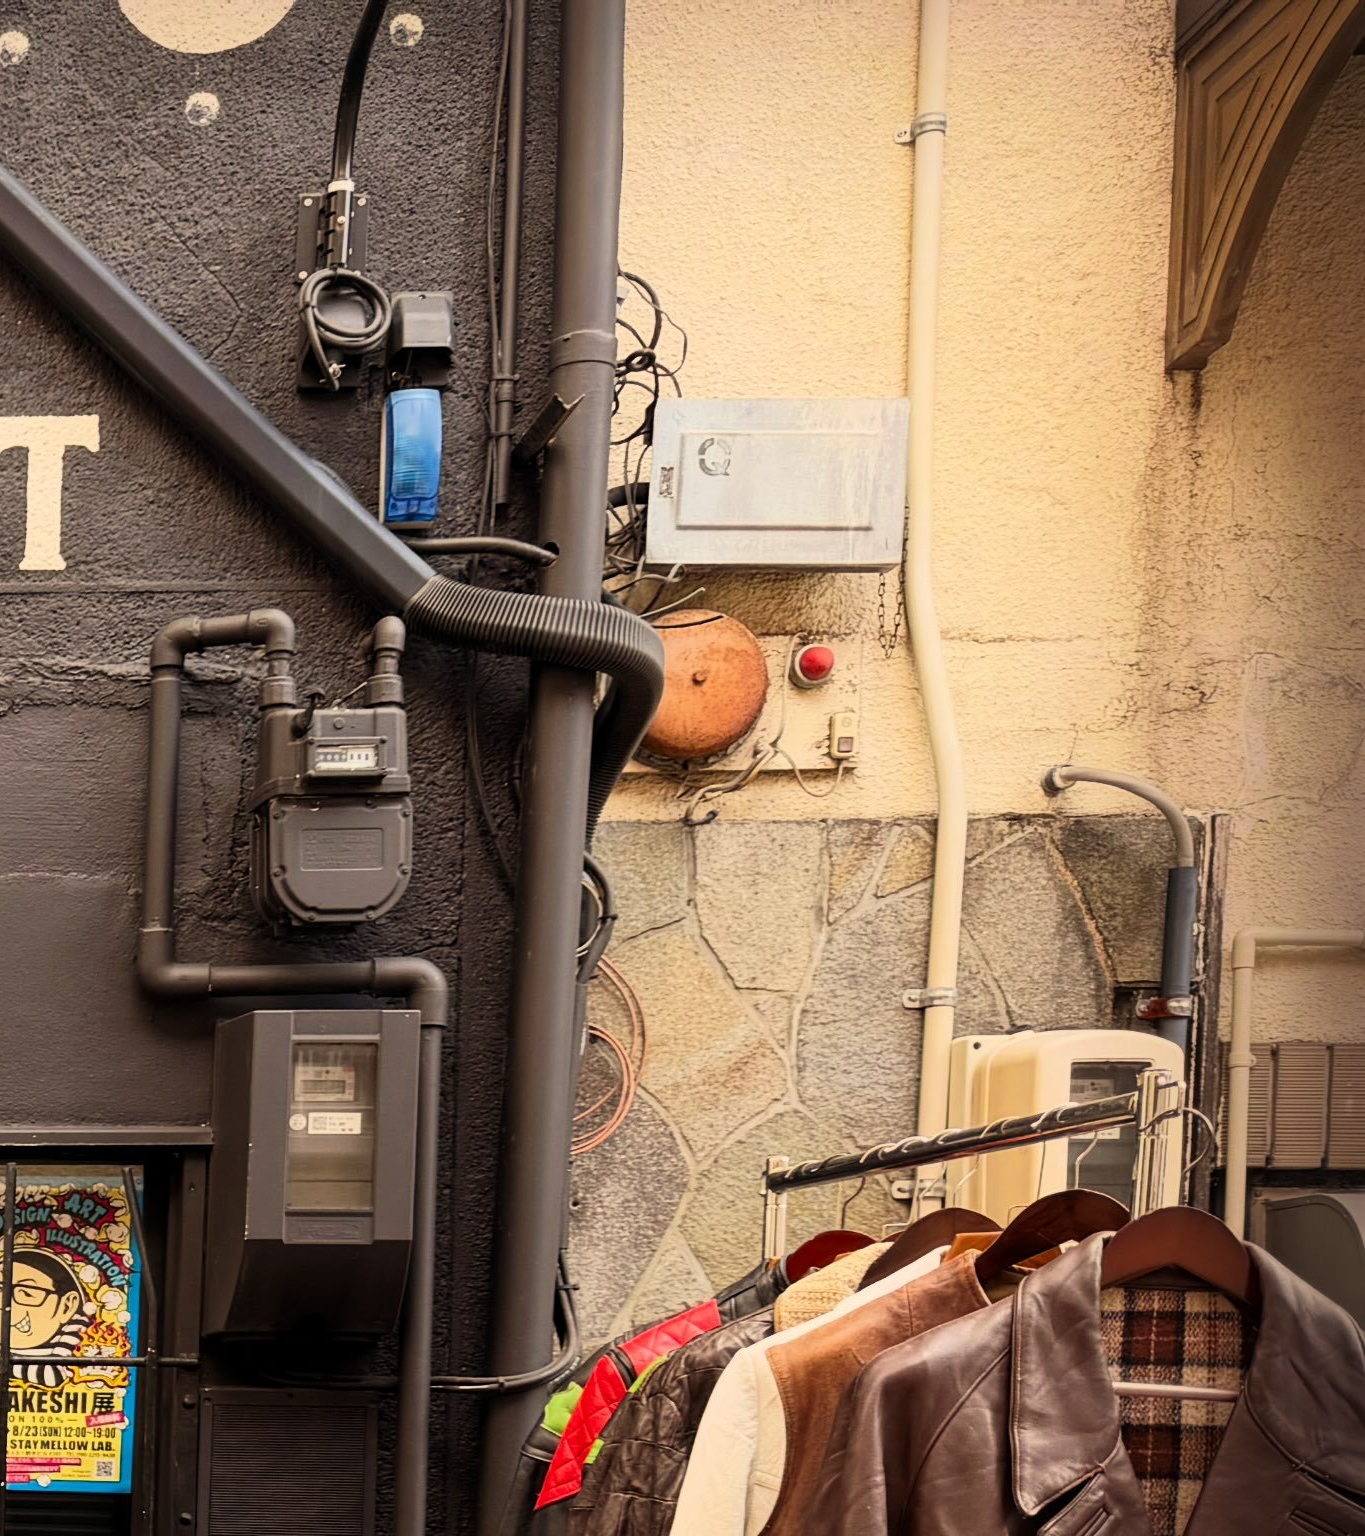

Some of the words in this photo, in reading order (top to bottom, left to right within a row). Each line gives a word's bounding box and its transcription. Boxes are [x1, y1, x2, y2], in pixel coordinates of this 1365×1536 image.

[65, 1193, 107, 1224] ART
[46, 1228, 127, 1288] ILLUSTRATION
[91, 1392, 116, 1414] 展
[32, 1416, 65, 1424] 100%
[10, 1440, 39, 1450] STAY
[40, 1440, 89, 1451] MELLOW
[91, 1441, 116, 1452] LAB.
